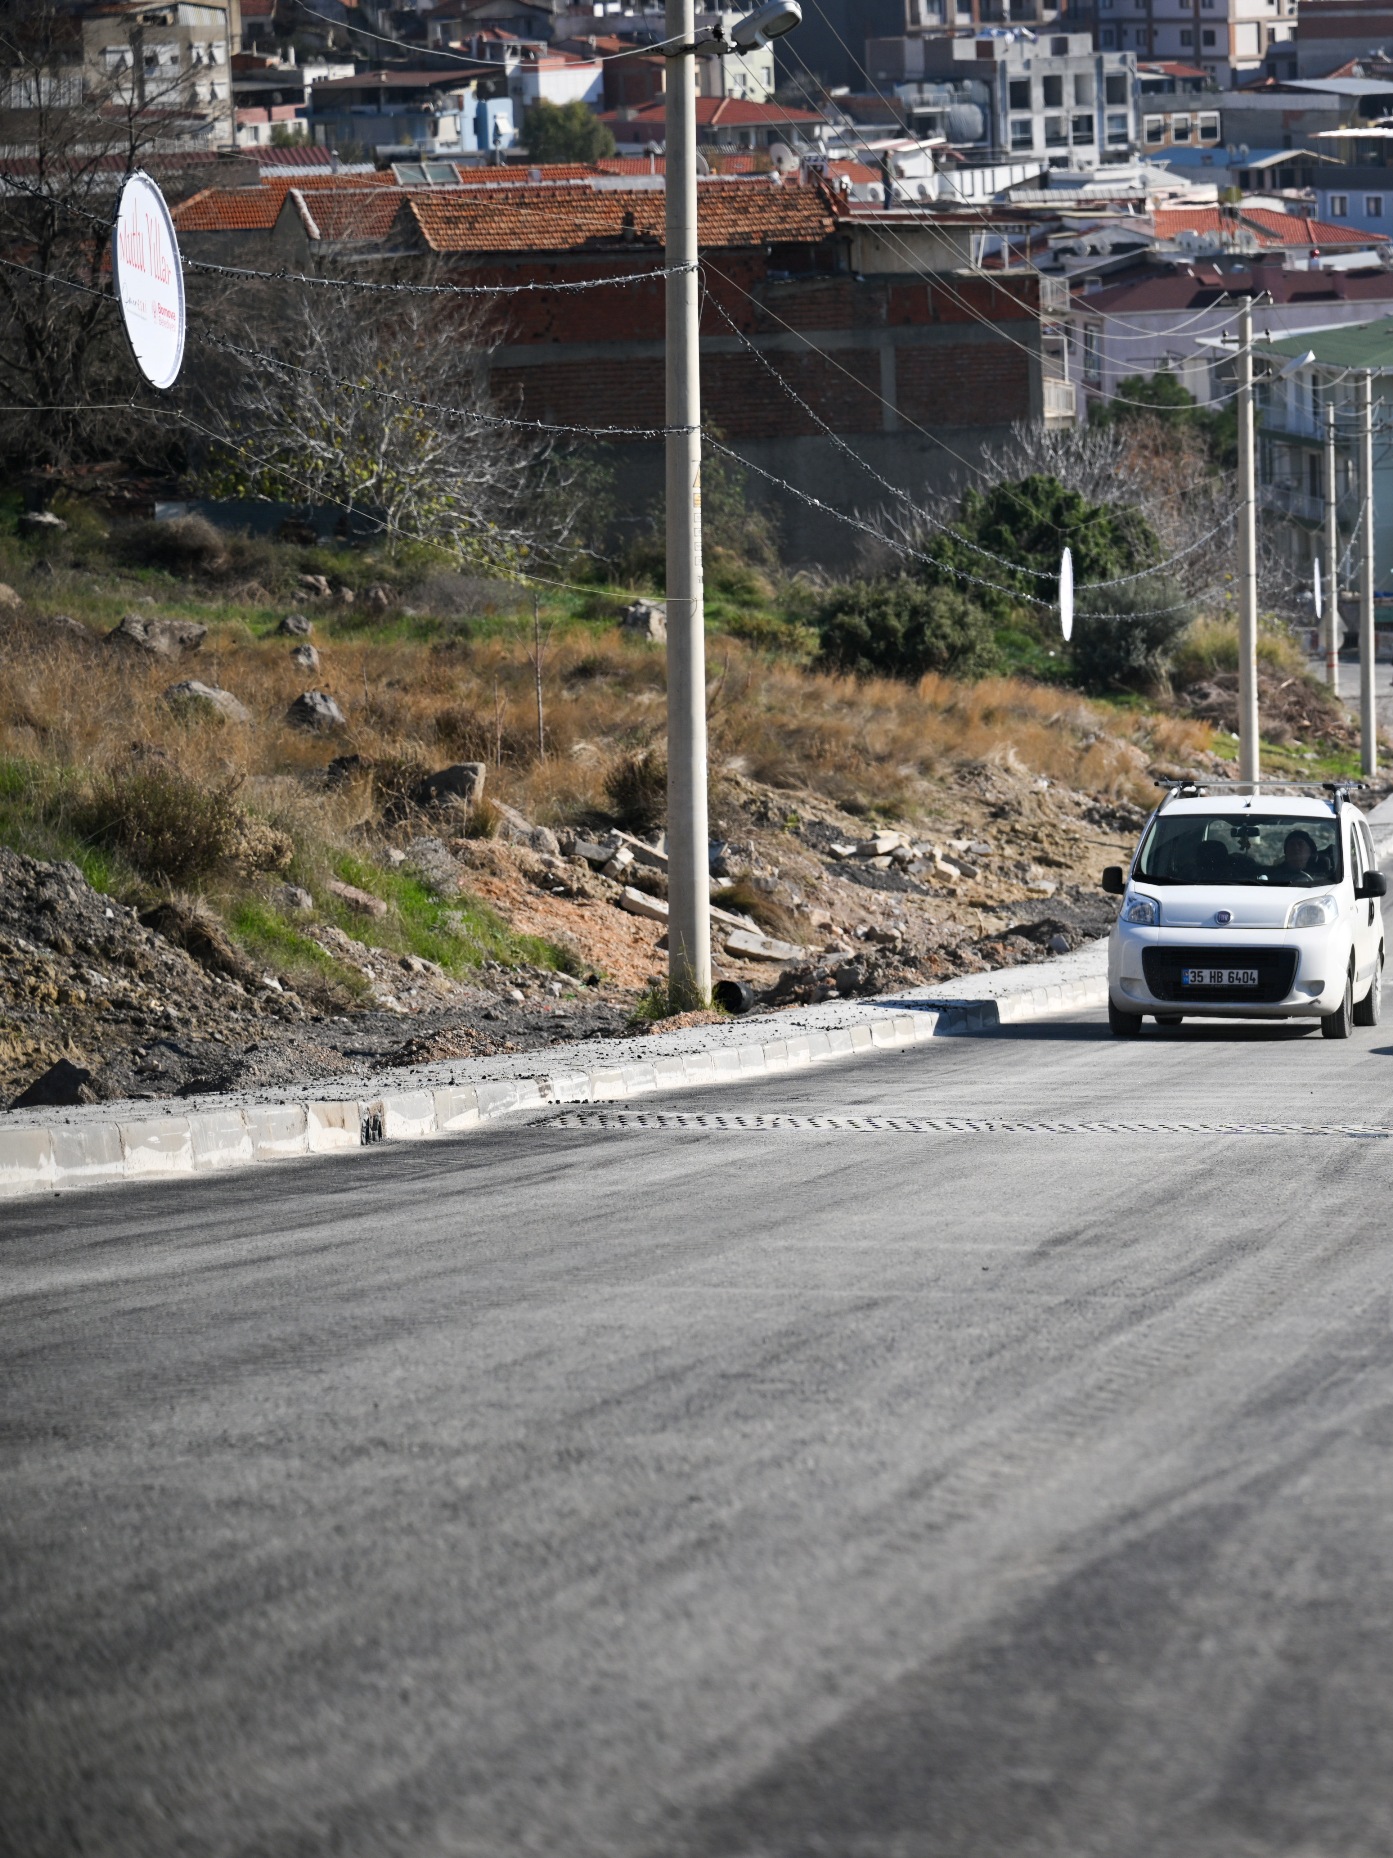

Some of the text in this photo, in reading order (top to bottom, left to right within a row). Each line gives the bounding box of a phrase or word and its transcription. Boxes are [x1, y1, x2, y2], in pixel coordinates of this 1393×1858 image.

[119, 197, 146, 273] Mutlu
[1190, 971, 1256, 984] 35 HB 6404
